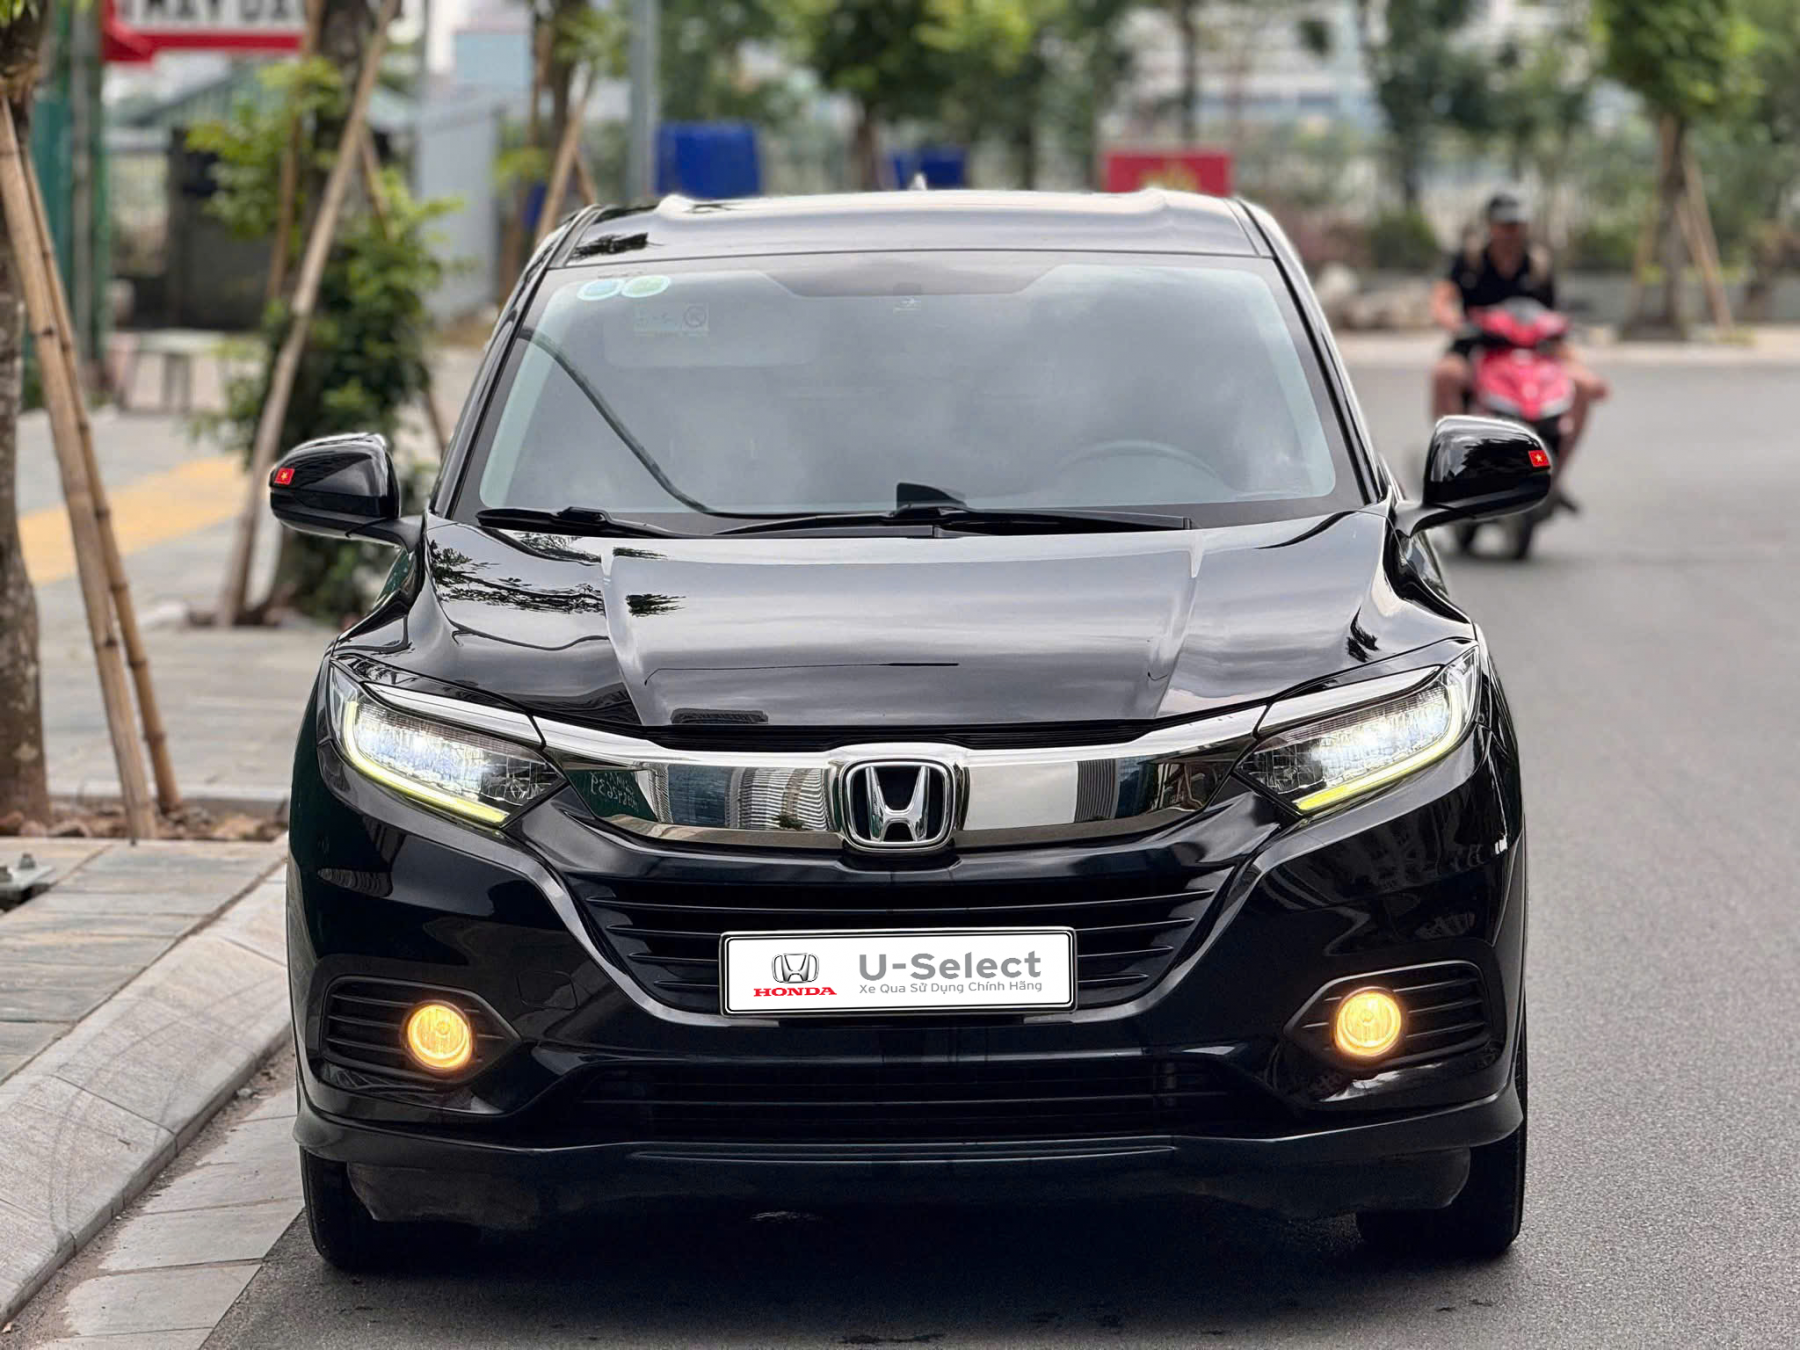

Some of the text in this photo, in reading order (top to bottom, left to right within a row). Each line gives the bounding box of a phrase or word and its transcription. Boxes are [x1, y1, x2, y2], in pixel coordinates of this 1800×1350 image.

[859, 950, 1041, 981] U-Select
[753, 987, 837, 997] HONDA
[859, 980, 1042, 995] Xe Qua Sử Dụng Chính Hãng
